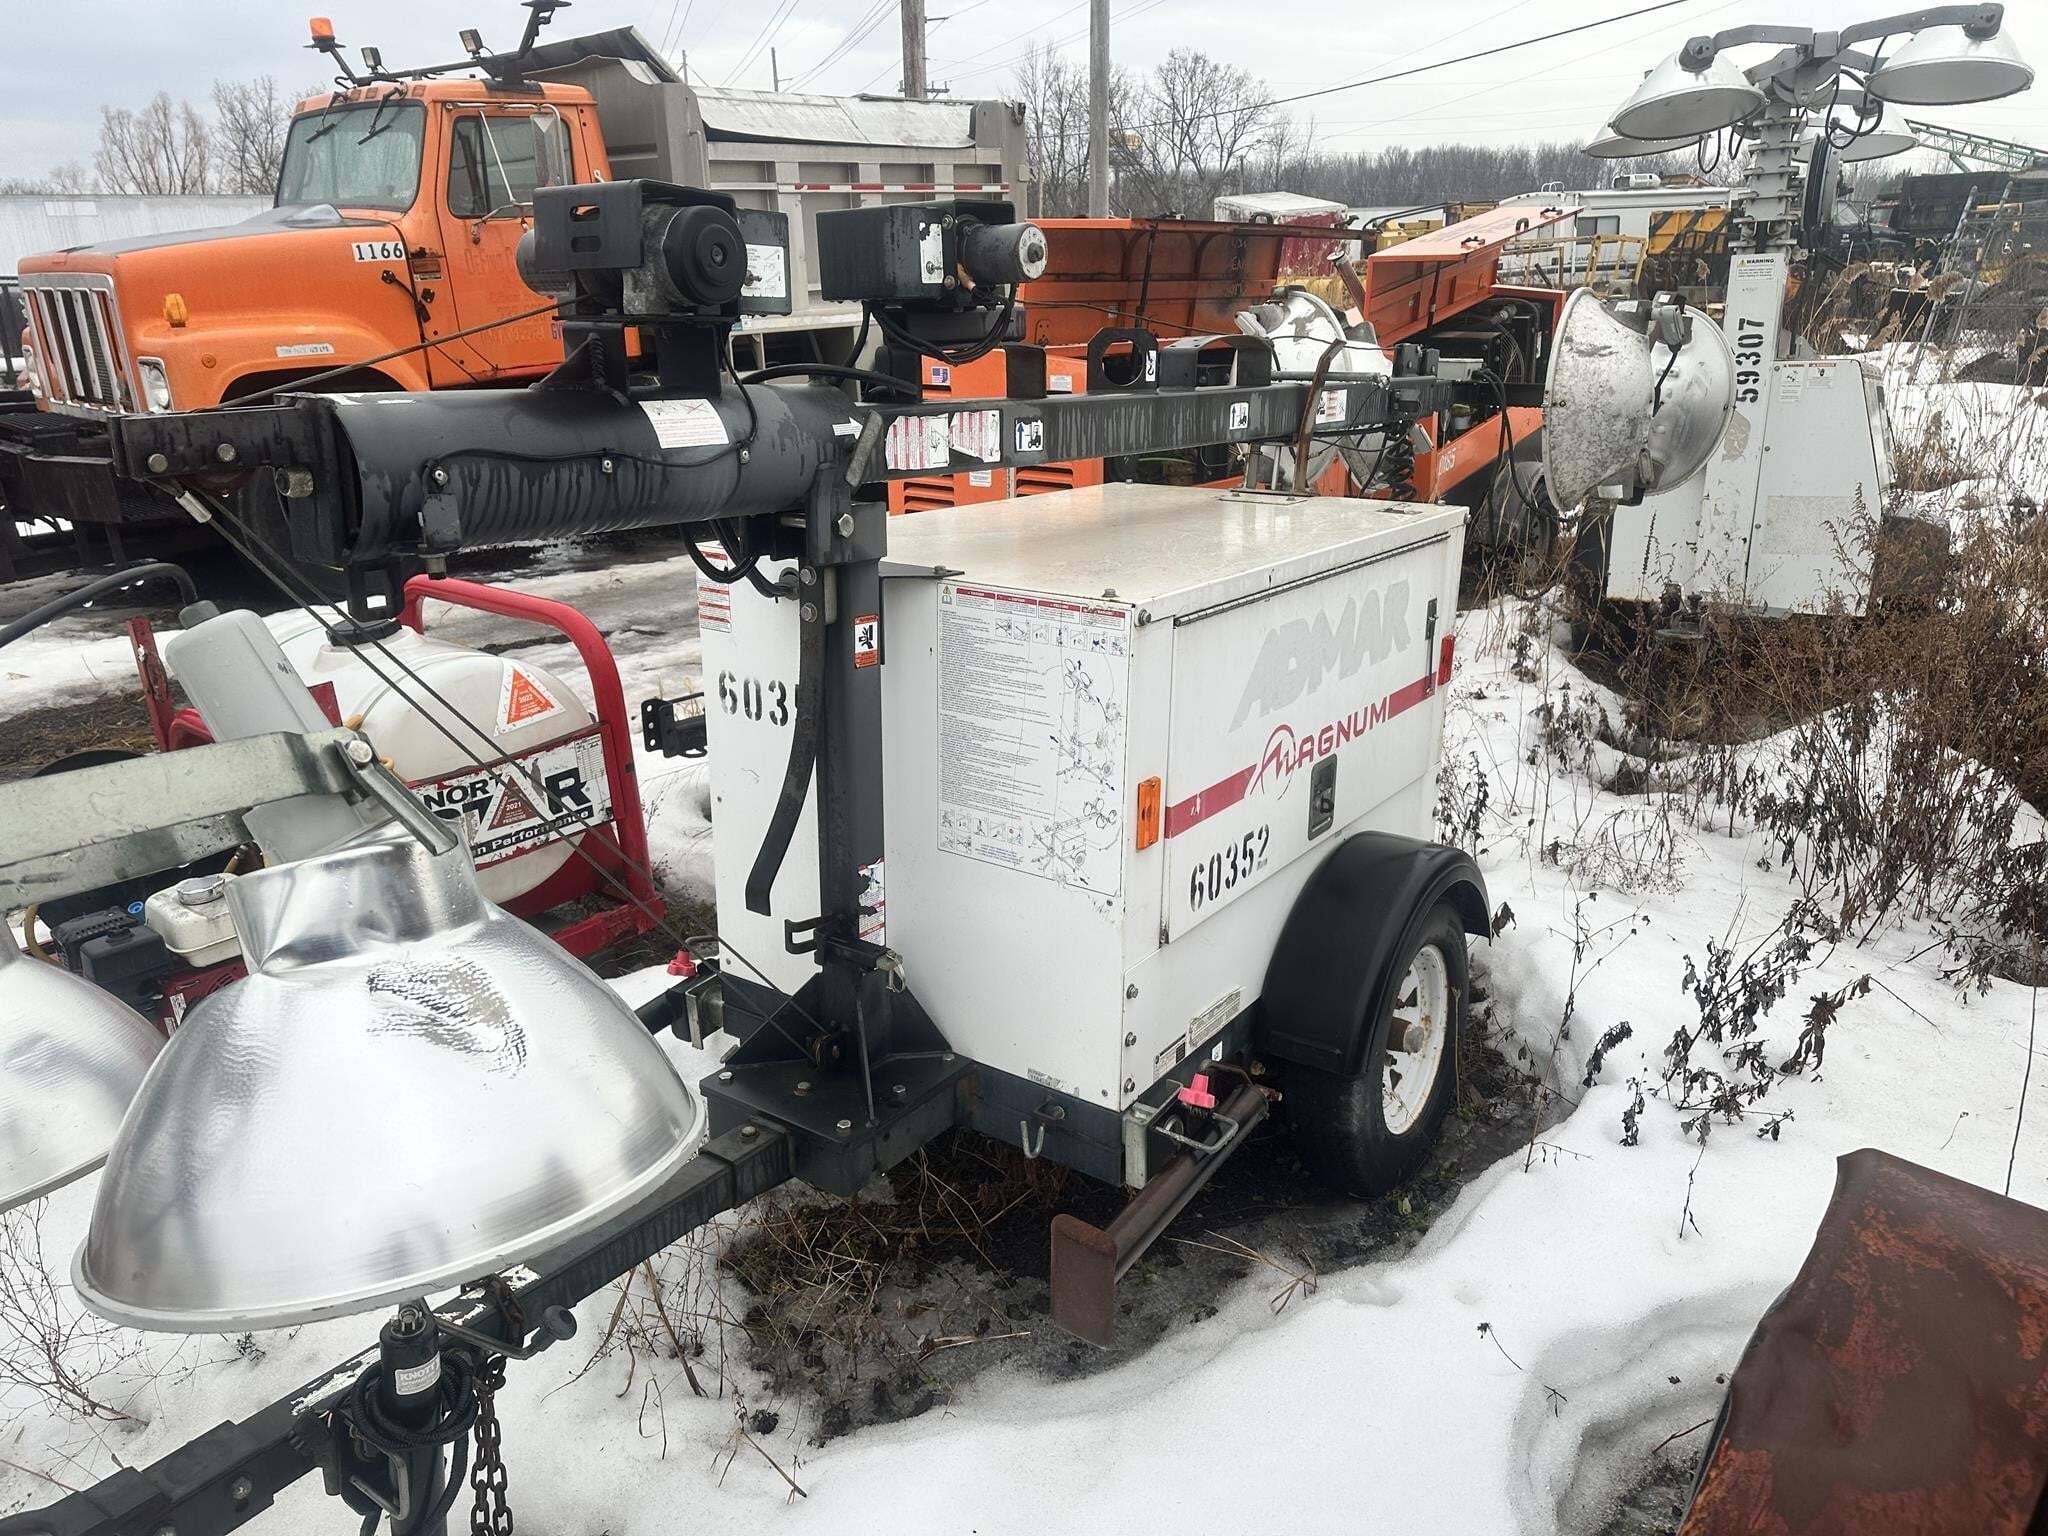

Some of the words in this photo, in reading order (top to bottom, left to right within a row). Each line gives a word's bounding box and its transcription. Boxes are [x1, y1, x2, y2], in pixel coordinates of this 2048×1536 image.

[355, 242, 403, 260] 1166
[1735, 317, 1765, 404] 59307
[718, 668, 800, 727] 603
[1249, 695, 1388, 800] MAGNUM
[506, 801, 522, 811] 2021
[1189, 823, 1270, 912] 60352
